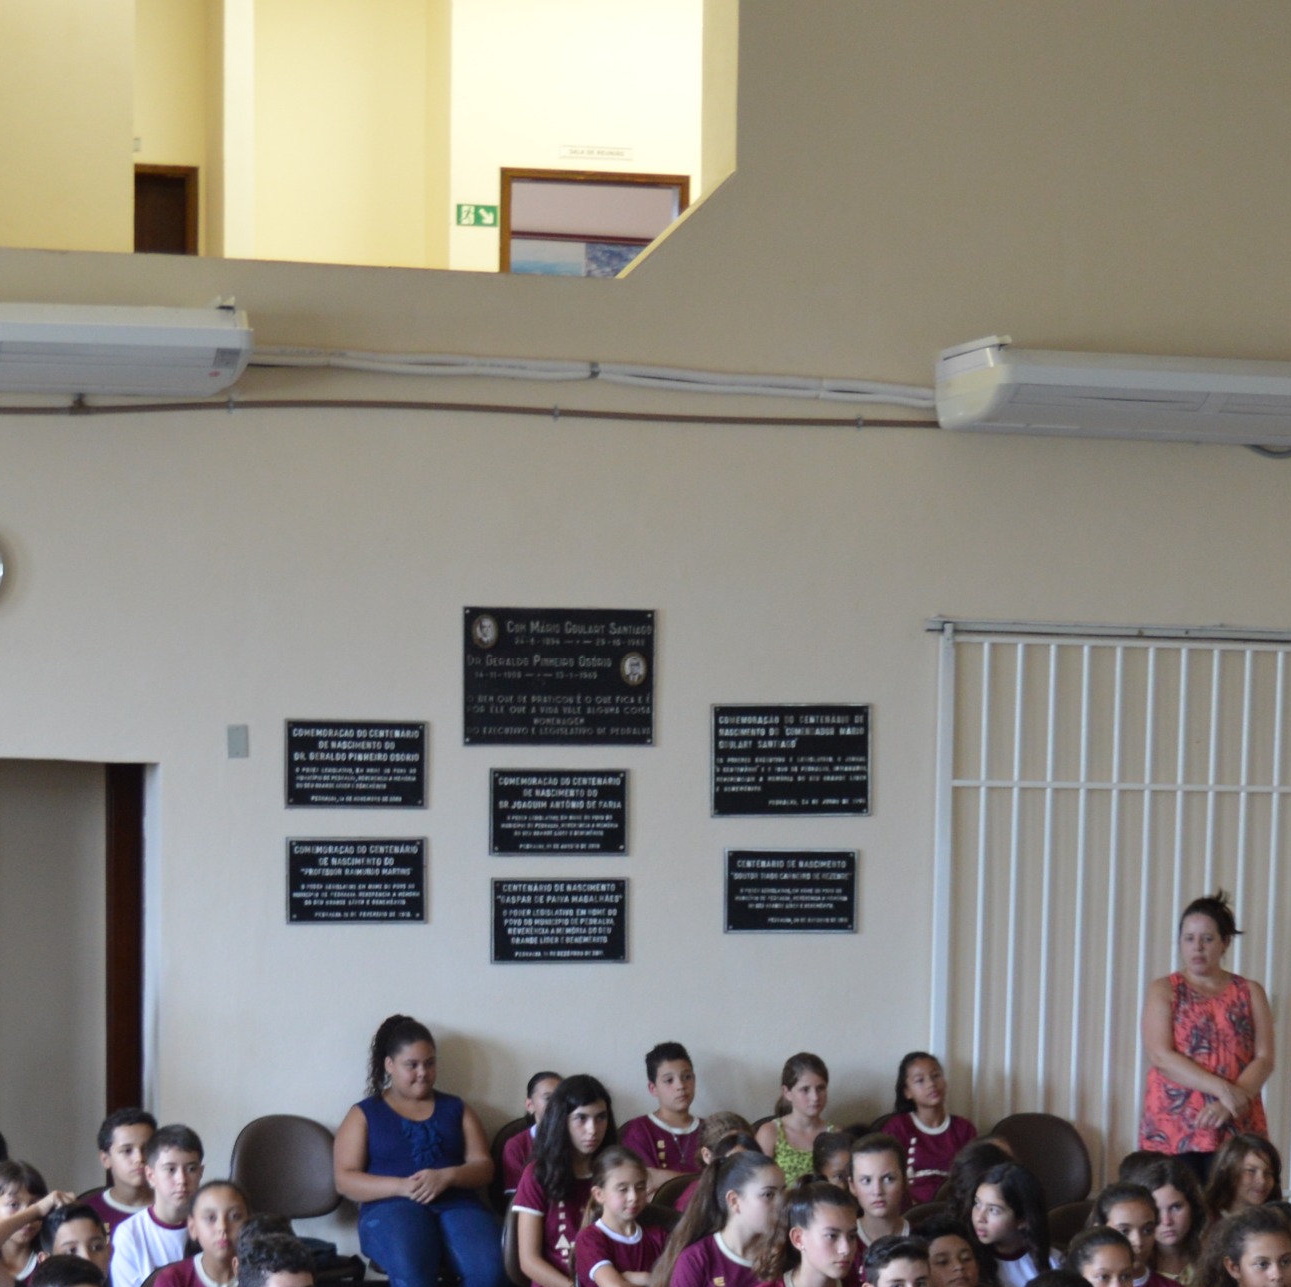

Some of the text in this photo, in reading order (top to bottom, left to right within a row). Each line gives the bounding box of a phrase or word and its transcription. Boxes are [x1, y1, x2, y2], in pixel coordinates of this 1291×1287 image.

[331, 741, 382, 750] NASCIMENTO
[309, 752, 347, 761] GERALDO
[348, 752, 388, 761] PINHEIRO
[535, 788, 585, 797] NASCIMENTO
[502, 883, 616, 892] CENTENÁRIO DE NASCIMENTO
